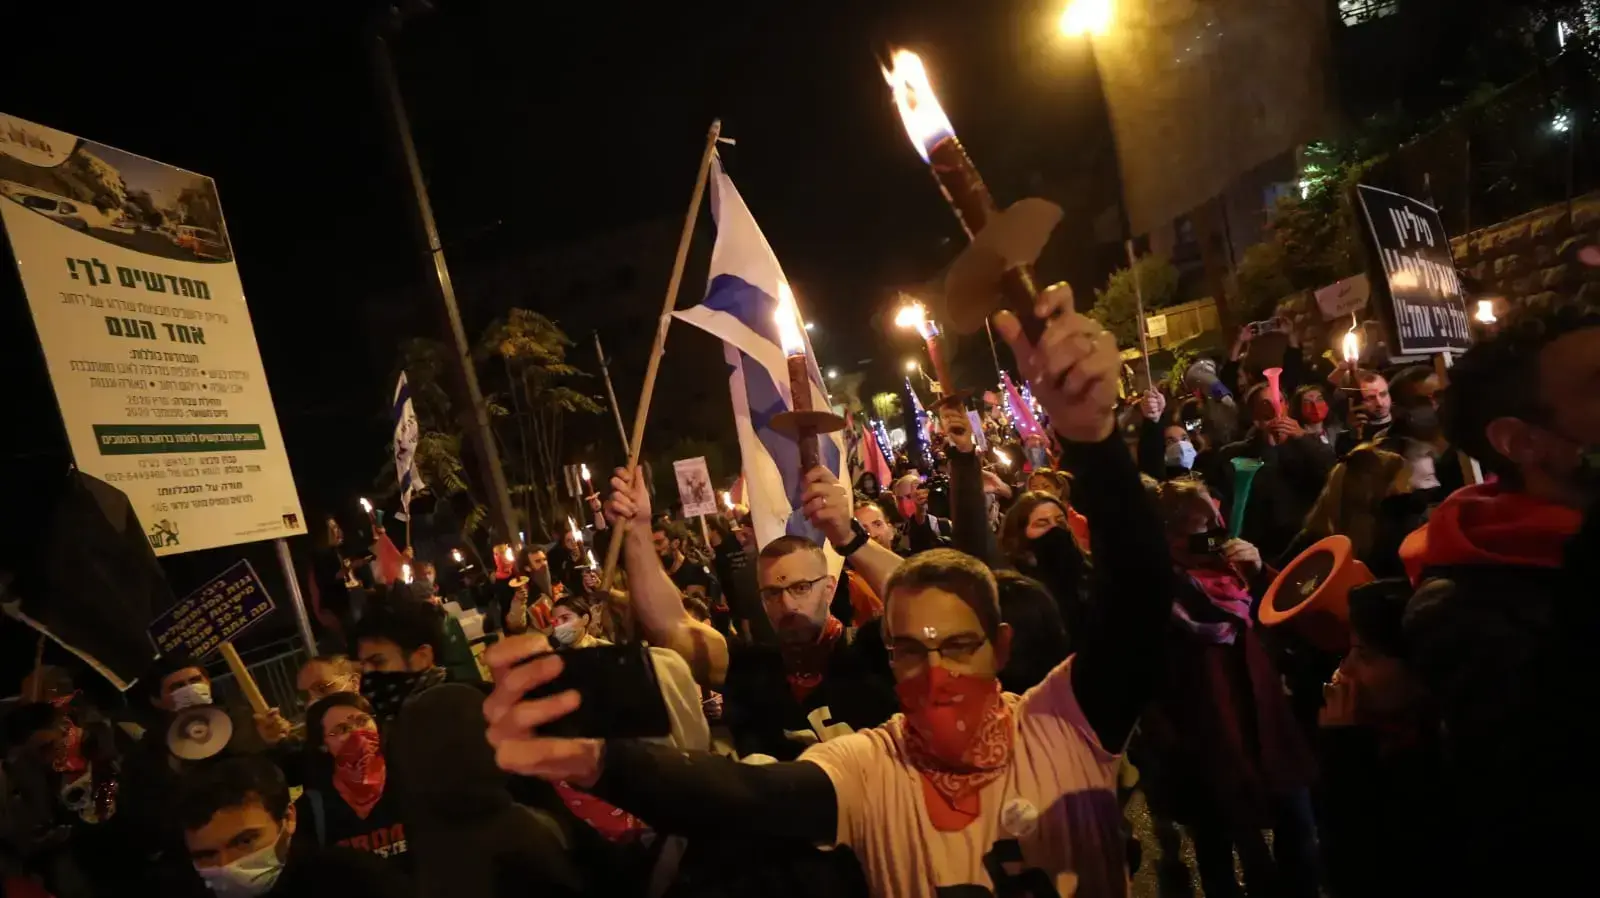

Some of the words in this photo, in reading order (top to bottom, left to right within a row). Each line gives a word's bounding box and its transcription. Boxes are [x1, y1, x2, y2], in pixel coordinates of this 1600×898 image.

[1389, 205, 1434, 248] מיליון
[65, 257, 111, 286] לך!
[116, 266, 211, 300] מחדשים
[59, 291, 86, 305] רחוב
[86, 293, 105, 308] של
[105, 315, 157, 340] העם
[161, 322, 206, 345] אחד
[205, 483, 218, 492] על
[250, 602, 268, 617] מה
[221, 615, 249, 637] אתה
